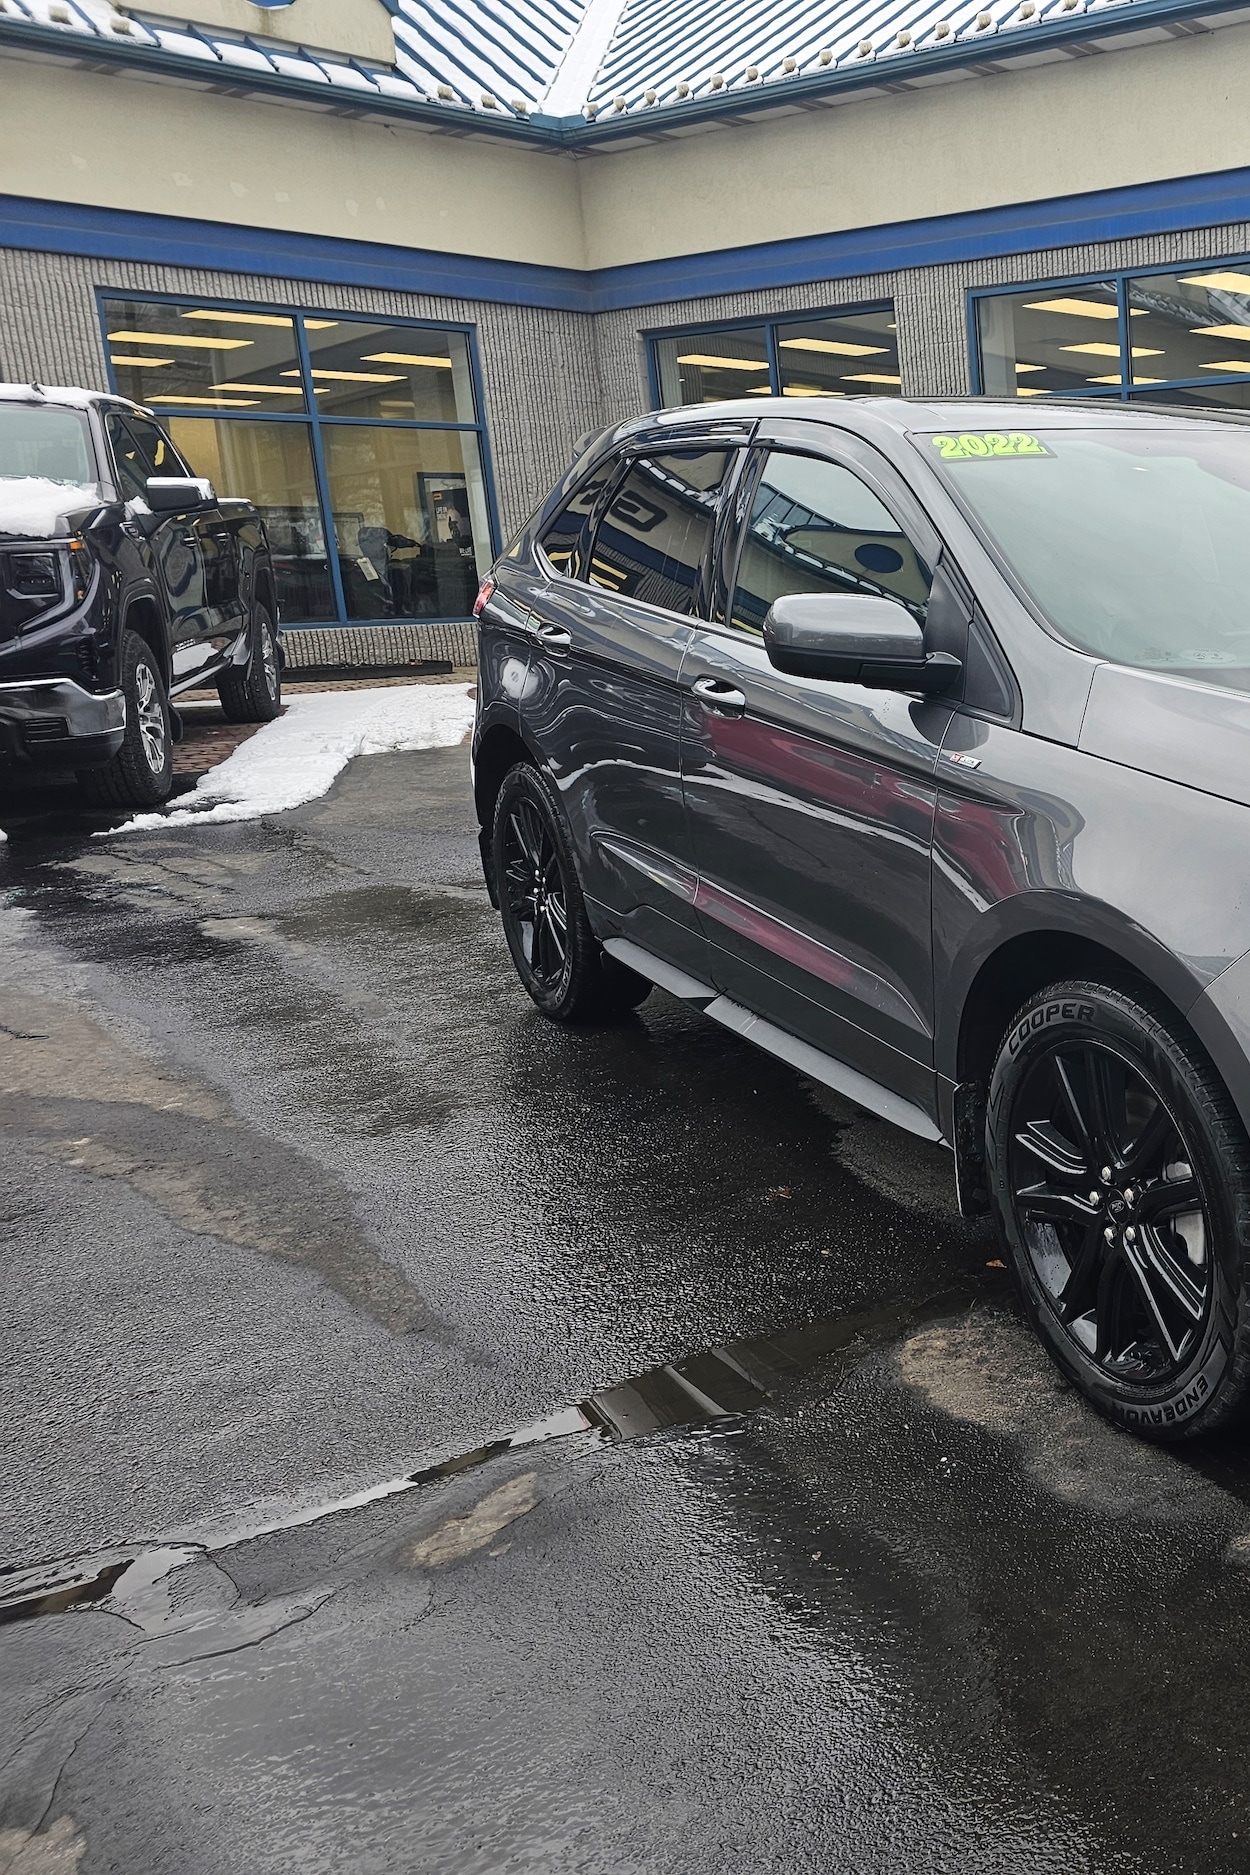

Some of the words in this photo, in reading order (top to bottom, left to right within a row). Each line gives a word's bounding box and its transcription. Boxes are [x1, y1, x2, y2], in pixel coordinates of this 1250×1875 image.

[932, 432, 1050, 459] 2022
[1008, 1003, 1095, 1056] COOPER
[1115, 1374, 1209, 1425] ENDEAVO
